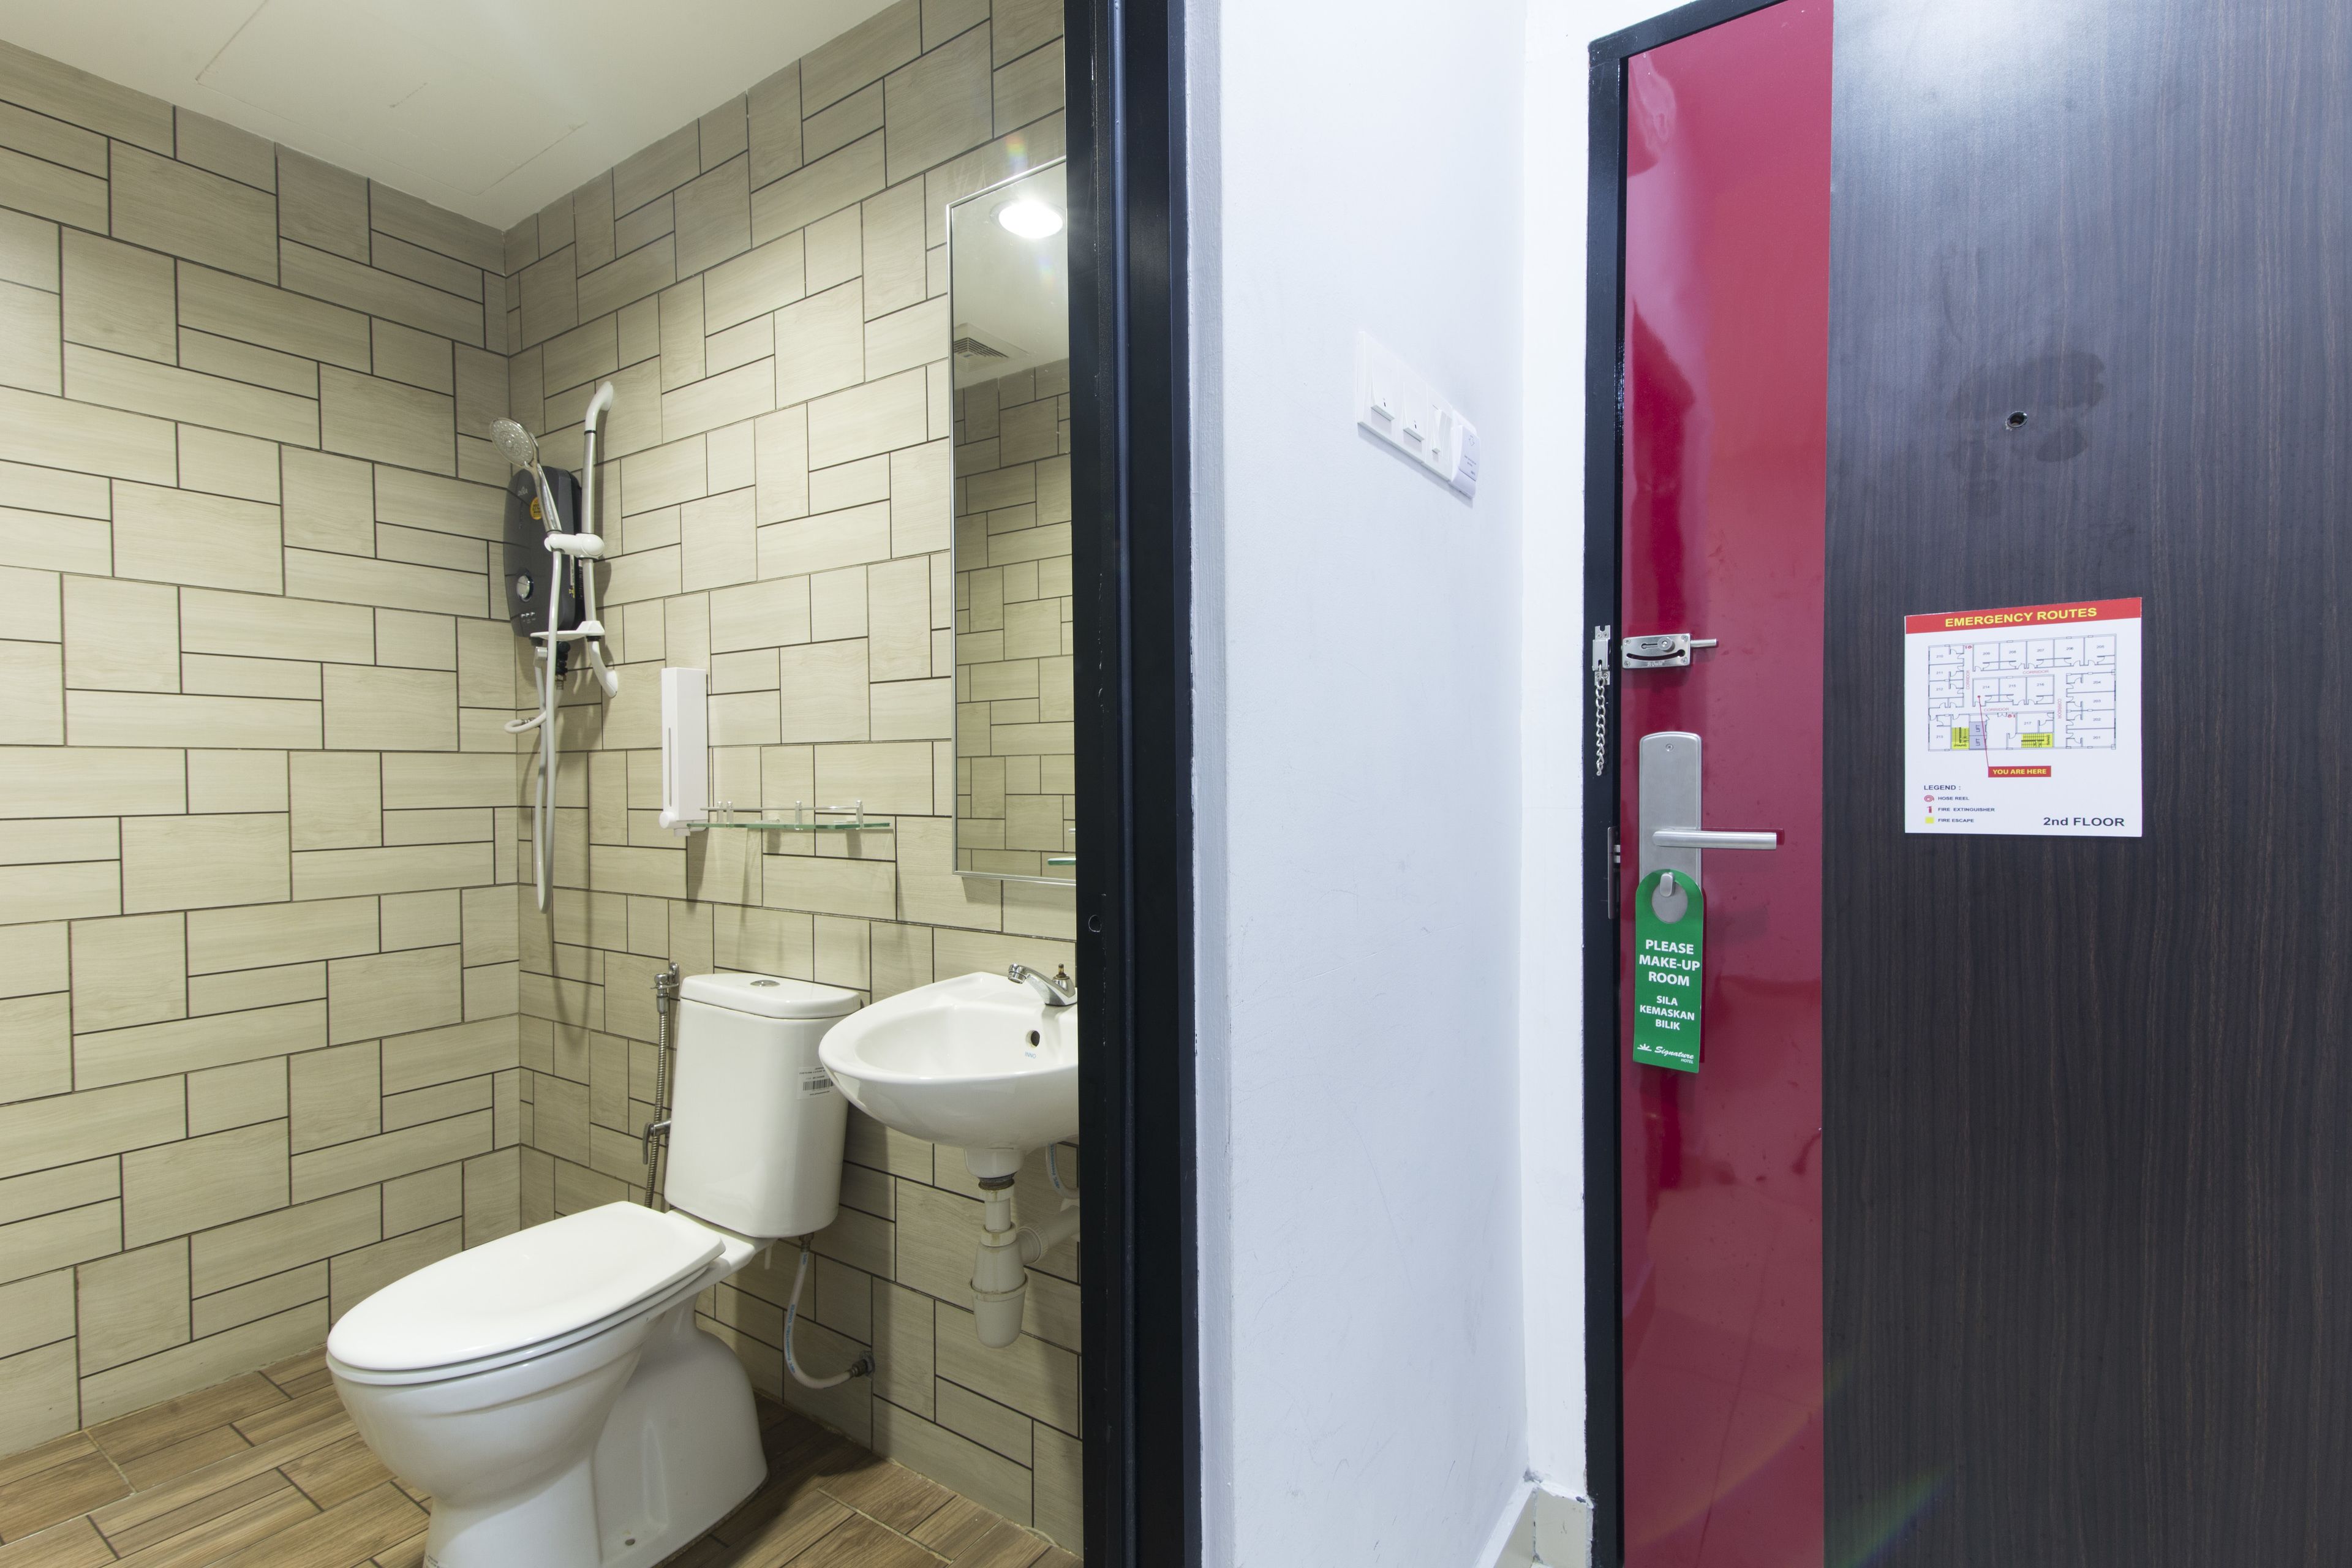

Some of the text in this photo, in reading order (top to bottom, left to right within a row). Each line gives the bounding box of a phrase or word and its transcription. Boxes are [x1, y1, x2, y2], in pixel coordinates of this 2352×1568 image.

[1945, 608, 2097, 627] EMERGENCY ROUTES
[2043, 817, 2125, 827] 2nd FLOOR
[1646, 939, 1694, 955] PLEASE
[1639, 954, 1700, 971] MAKE-UP
[1648, 971, 1689, 987] ROOM
[1656, 995, 1678, 1006] SILA
[1640, 1005, 1695, 1021] KEMASKAN
[1655, 1019, 1680, 1030] BILIK
[1654, 1046, 1694, 1060] Signature
